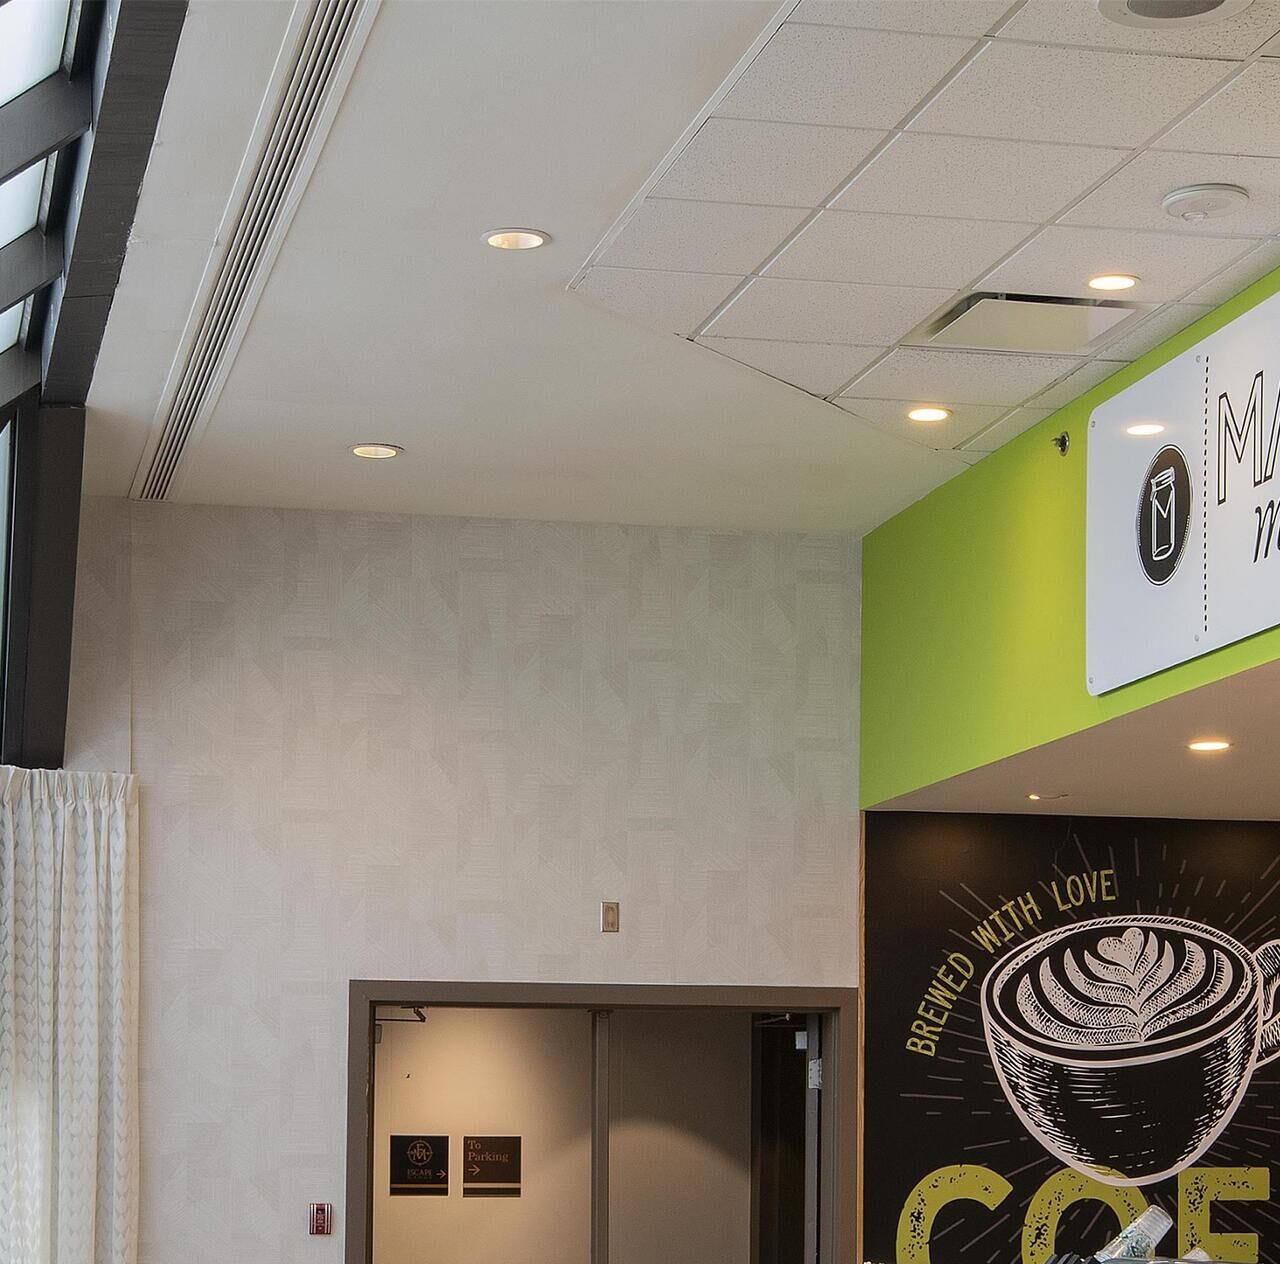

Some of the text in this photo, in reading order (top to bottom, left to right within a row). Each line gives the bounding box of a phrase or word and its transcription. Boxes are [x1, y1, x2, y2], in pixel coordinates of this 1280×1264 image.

[905, 869, 1117, 1057] BREWED WITH LOVE
[467, 1140, 481, 1150] To
[467, 1151, 509, 1162] Parking
